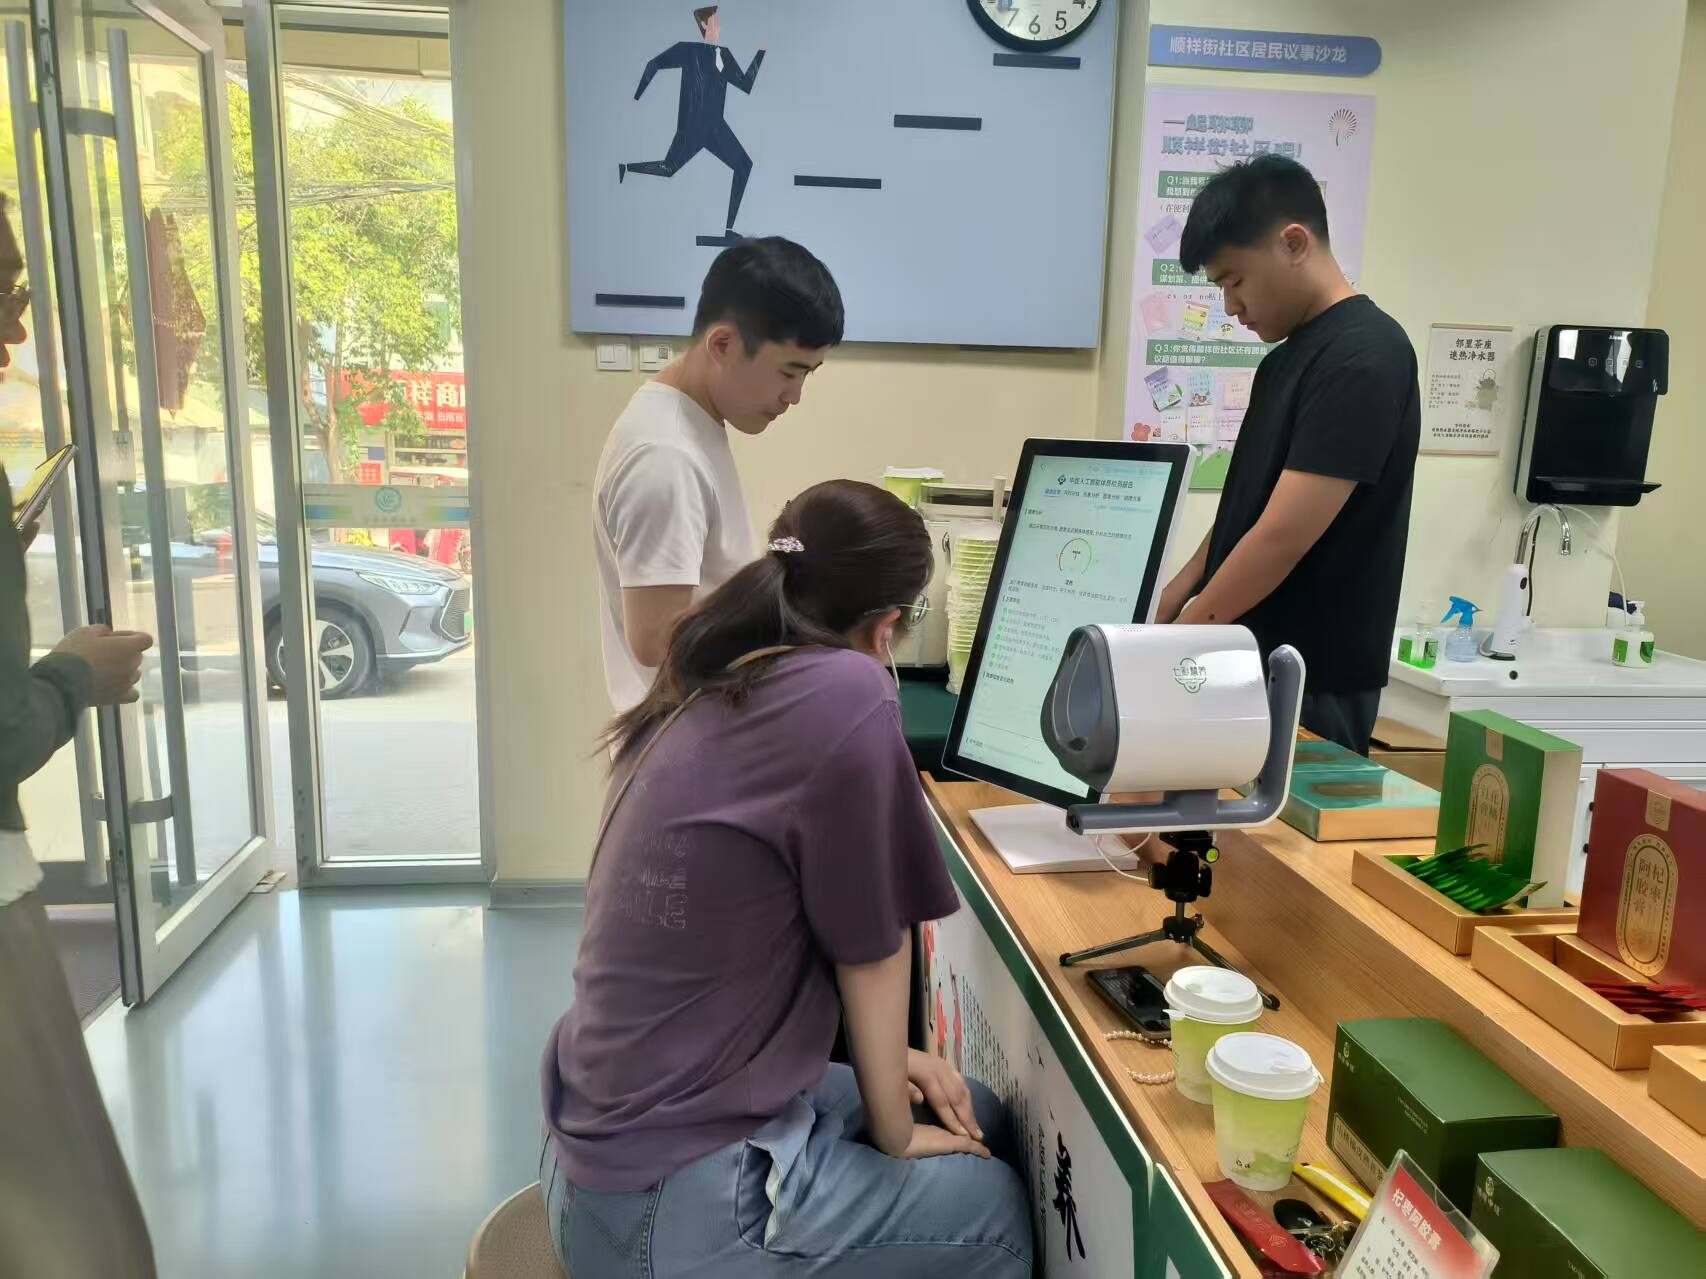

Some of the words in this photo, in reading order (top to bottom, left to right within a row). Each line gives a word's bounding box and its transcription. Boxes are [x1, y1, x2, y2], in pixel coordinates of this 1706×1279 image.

[1008, 7, 1019, 28] 7
[1028, 14, 1041, 35] 6
[1055, 10, 1067, 30] 5
[1168, 35, 1348, 64] 顺祥街社区居民议事沙龙
[1455, 339, 1492, 349] 邻里茶座
[1449, 351, 1496, 362] 速热净水器
